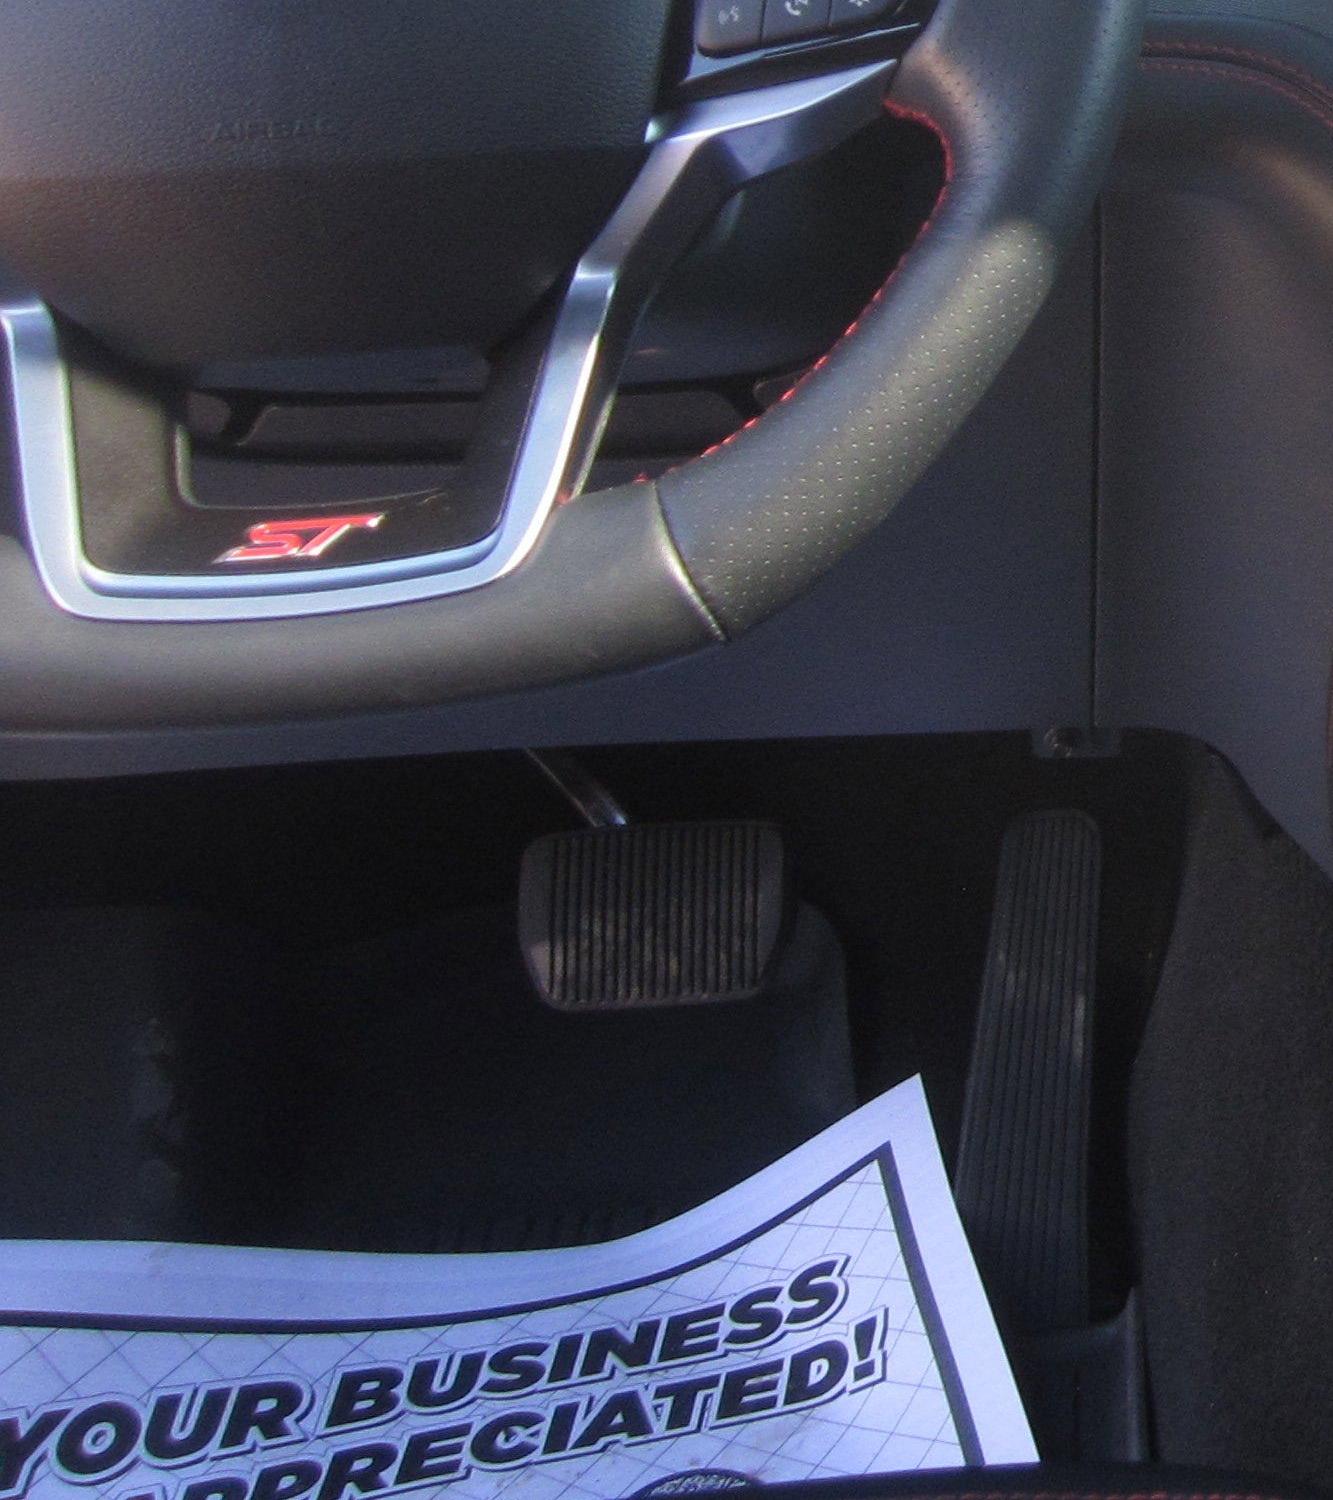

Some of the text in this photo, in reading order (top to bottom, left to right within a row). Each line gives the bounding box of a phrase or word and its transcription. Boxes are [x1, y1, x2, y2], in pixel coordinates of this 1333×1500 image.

[211, 513, 386, 564] ST
[0, 1257, 848, 1492] YOUR BUSINESS
